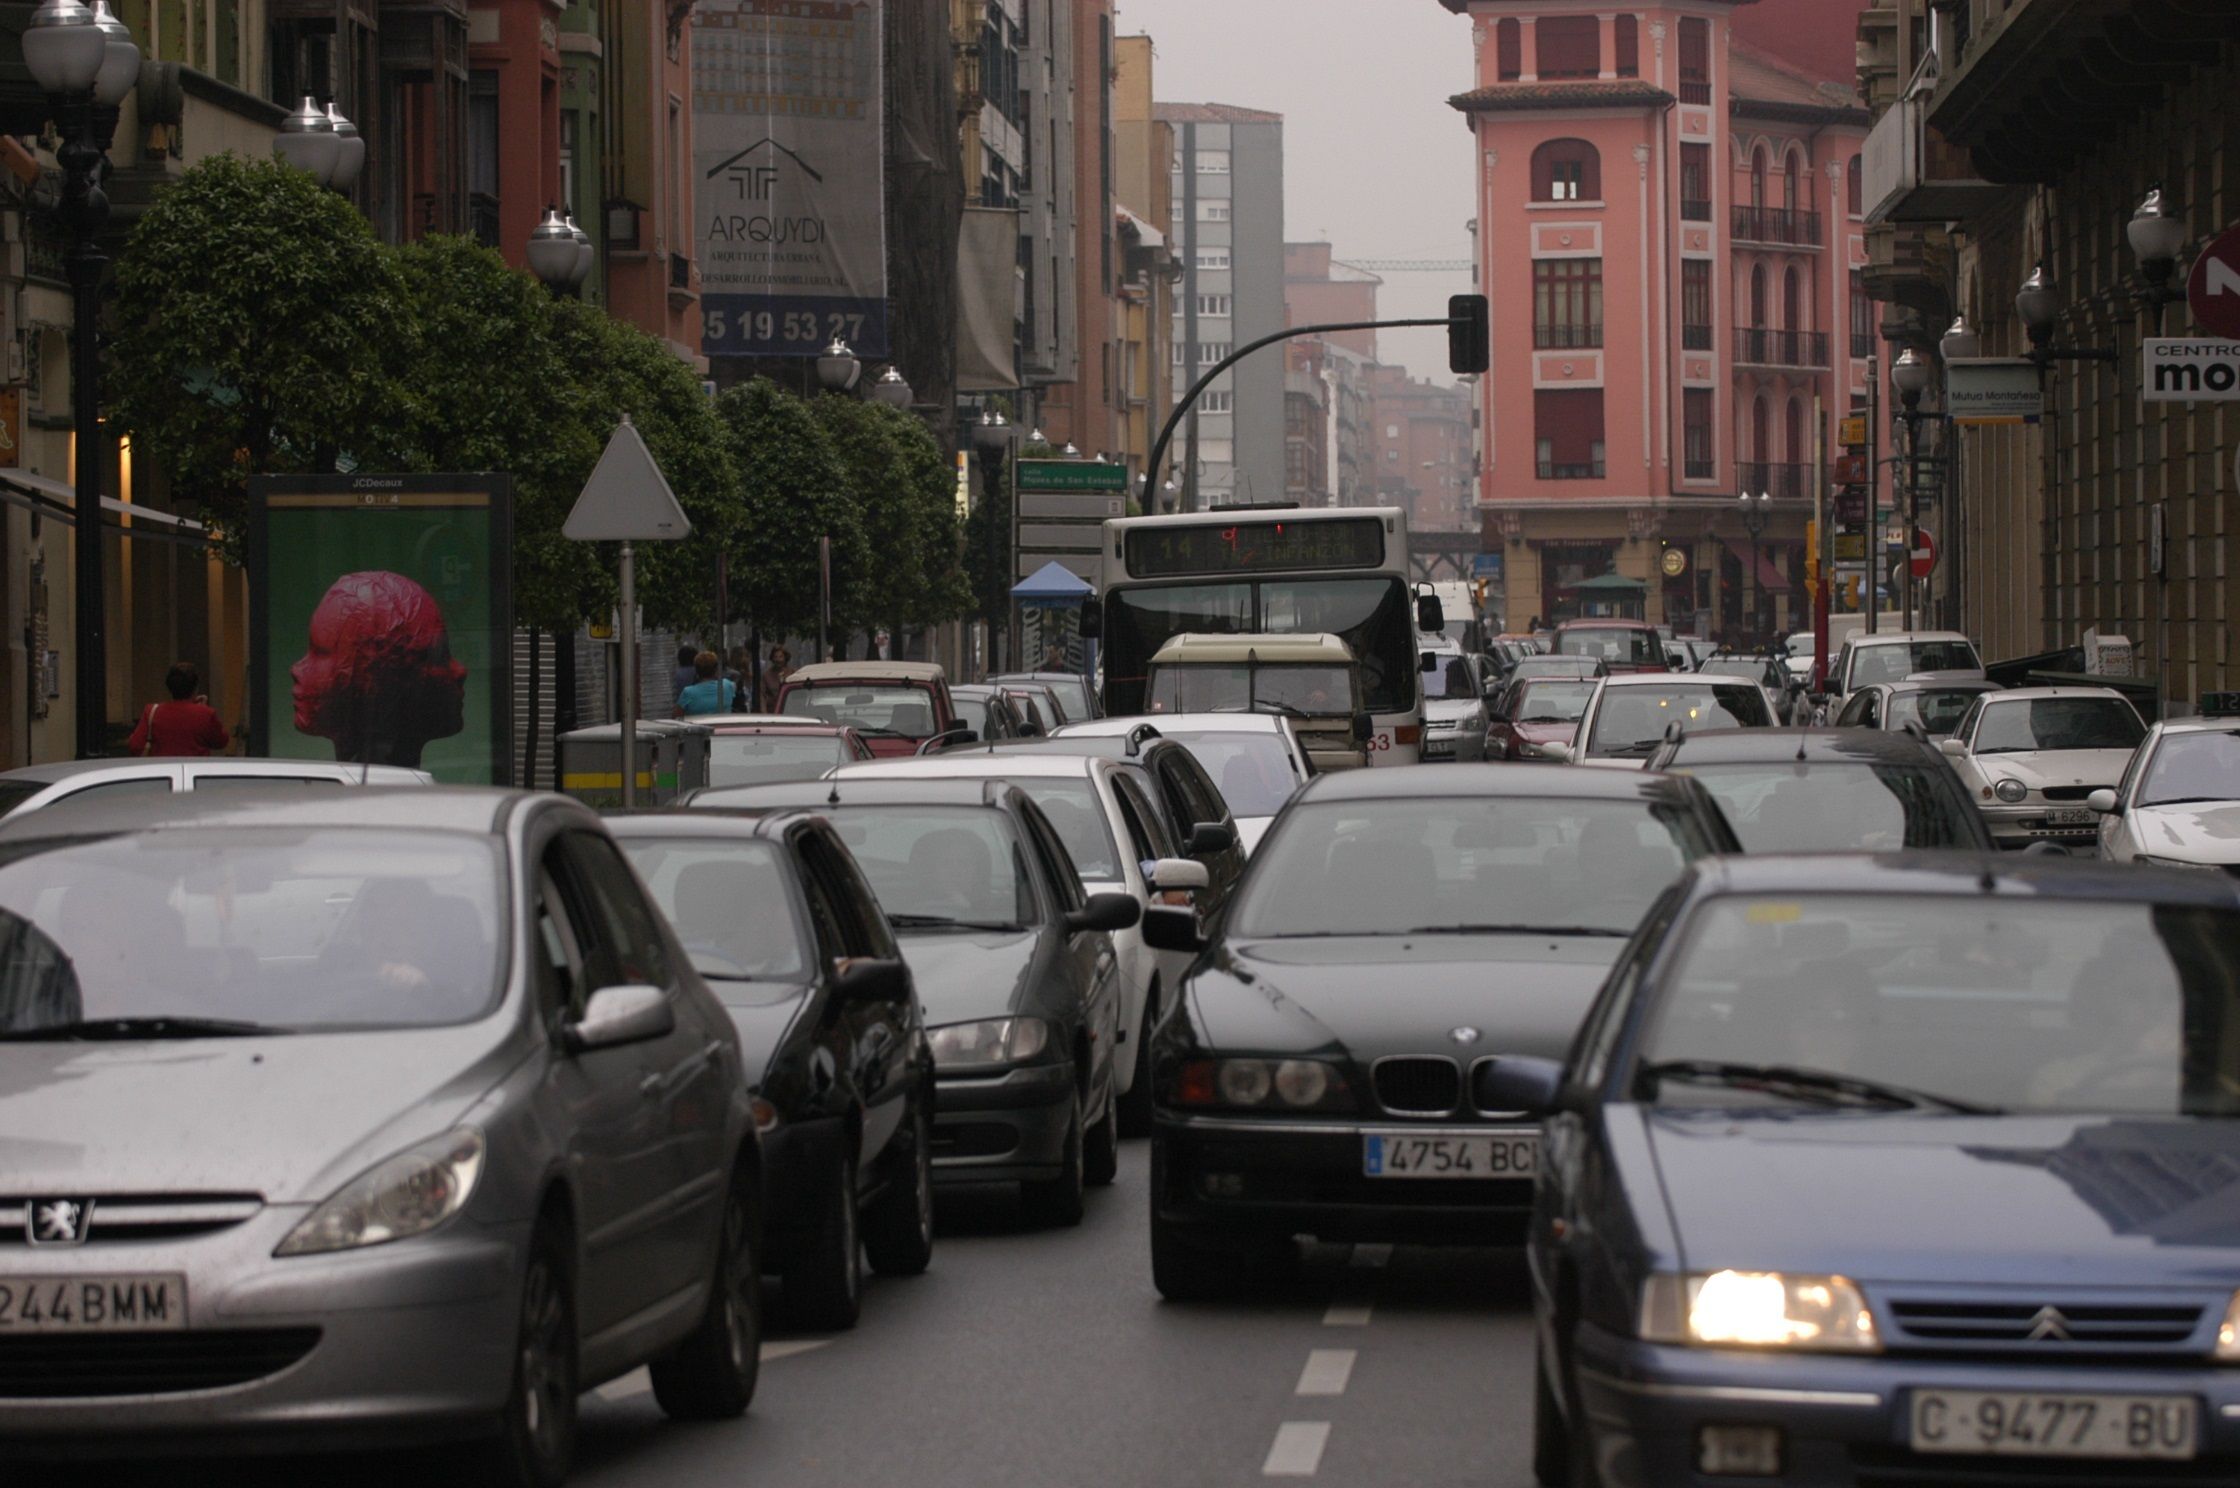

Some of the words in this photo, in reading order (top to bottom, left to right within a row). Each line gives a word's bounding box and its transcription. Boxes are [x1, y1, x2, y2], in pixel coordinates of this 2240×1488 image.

[708, 215, 825, 244] ARQUYDI
[737, 310, 774, 341] 19
[783, 312, 819, 342] 53
[827, 312, 866, 342] 27
[352, 478, 404, 488] JCDecaux
[1390, 1140, 1473, 1170] 4754
[1490, 1141, 1538, 1171] BC
